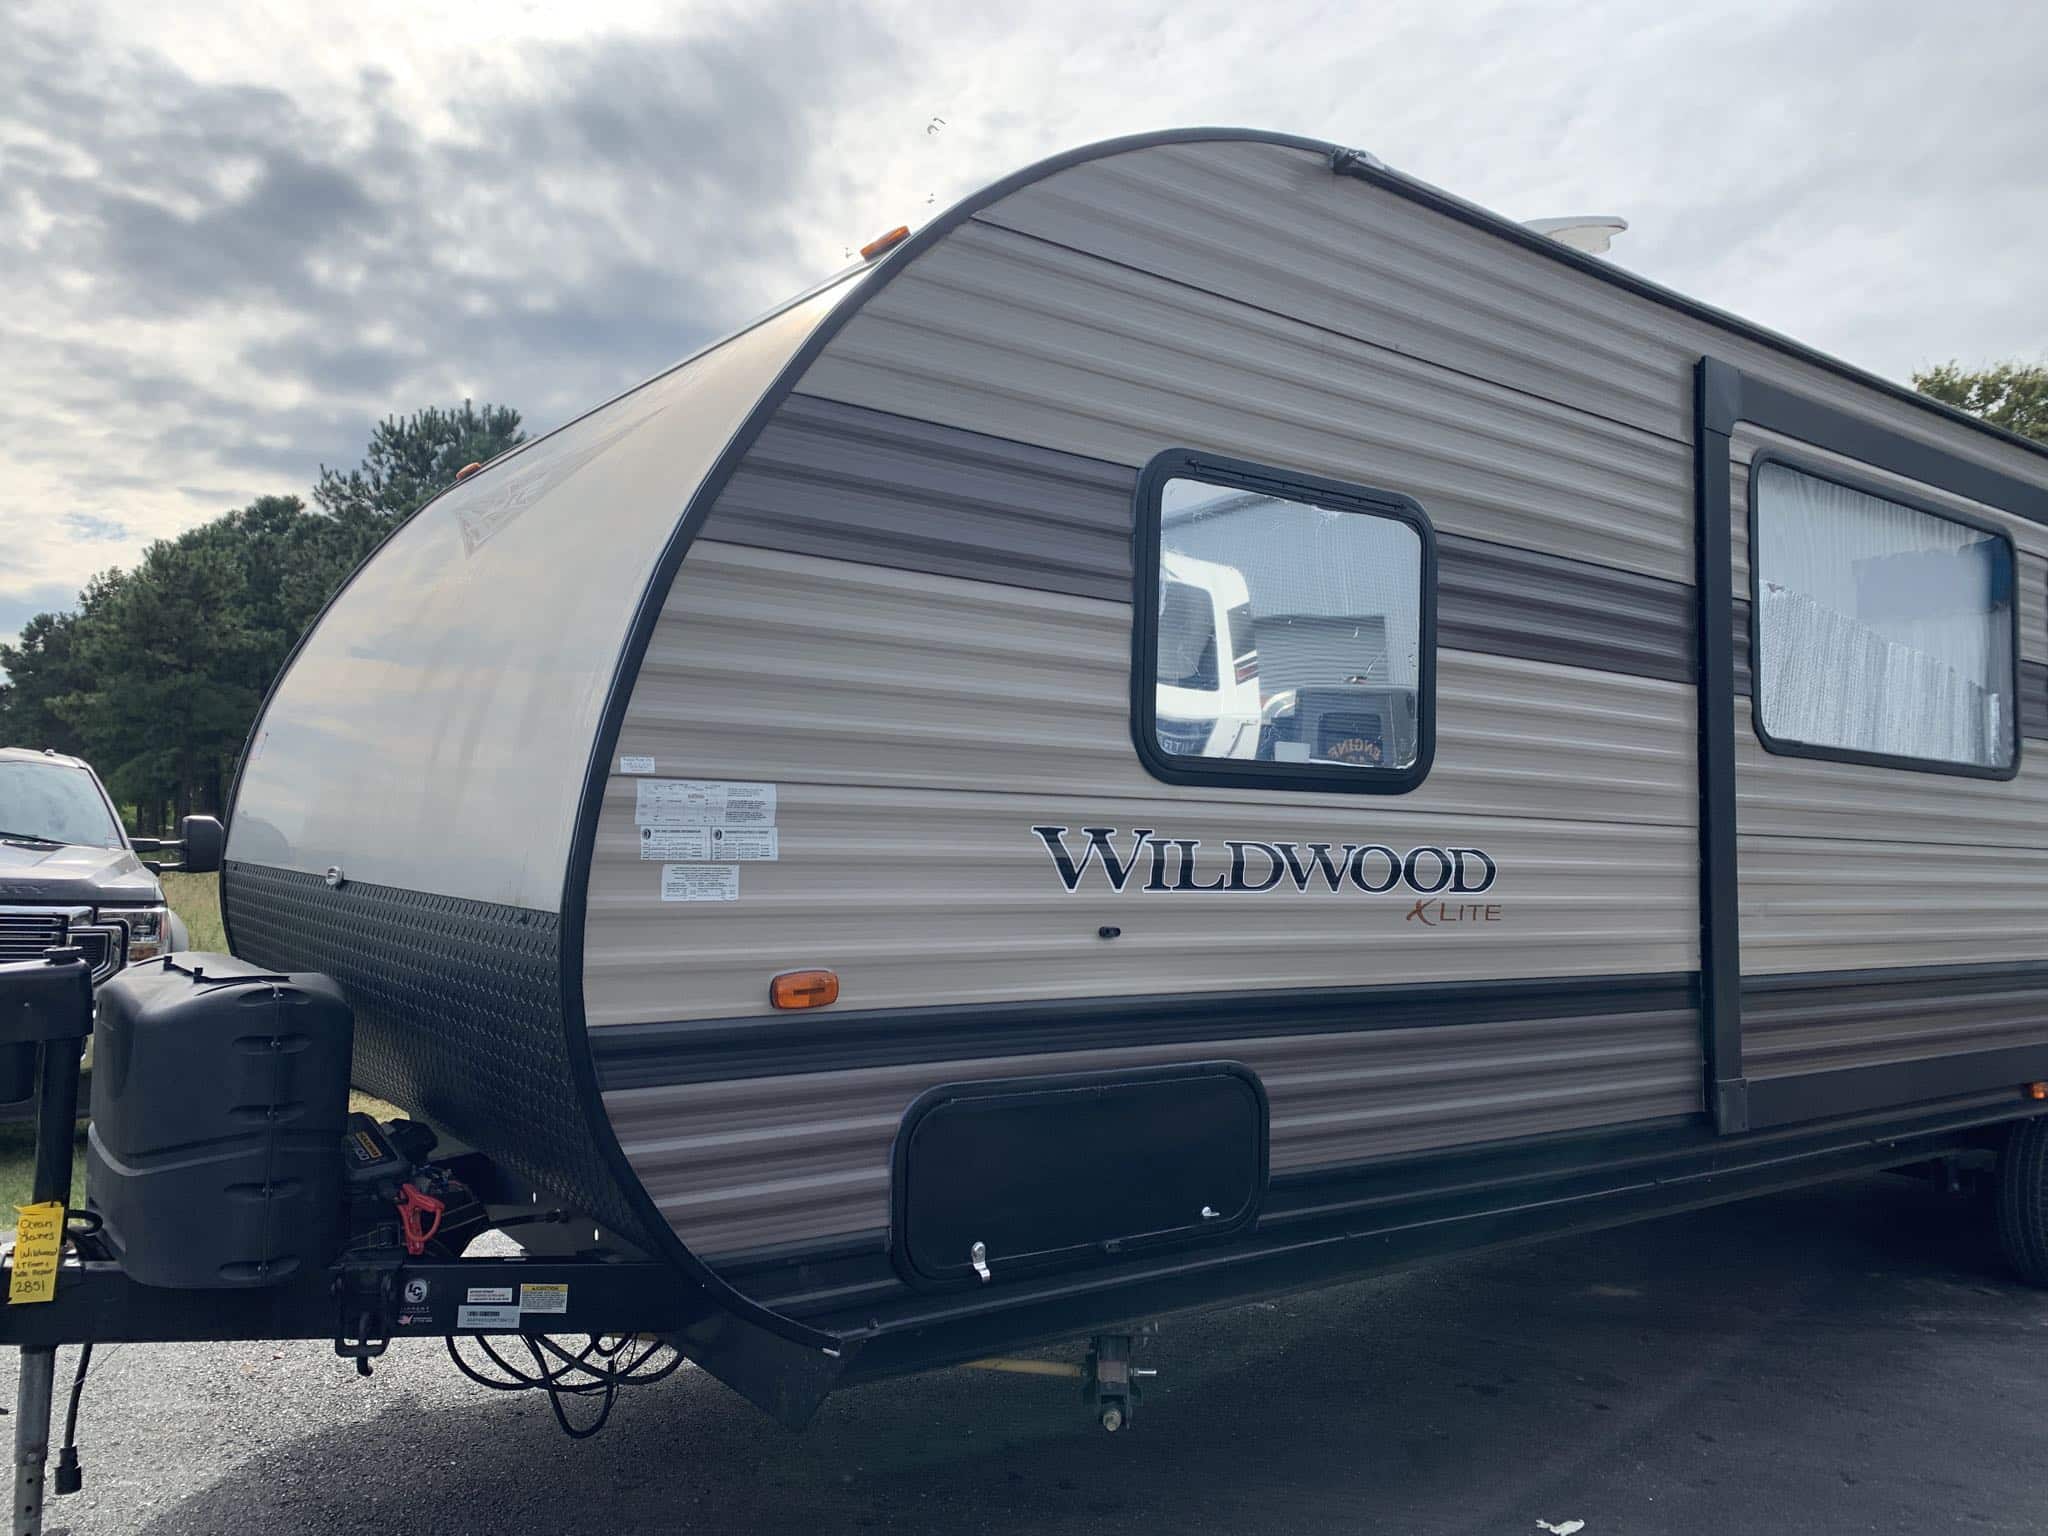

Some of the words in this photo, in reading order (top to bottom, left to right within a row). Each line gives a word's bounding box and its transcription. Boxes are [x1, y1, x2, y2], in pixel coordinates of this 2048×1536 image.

[1032, 826, 1496, 894] WILDWOOD
[1440, 902, 1502, 921] LITE
[15, 1280, 45, 1293] 2851
